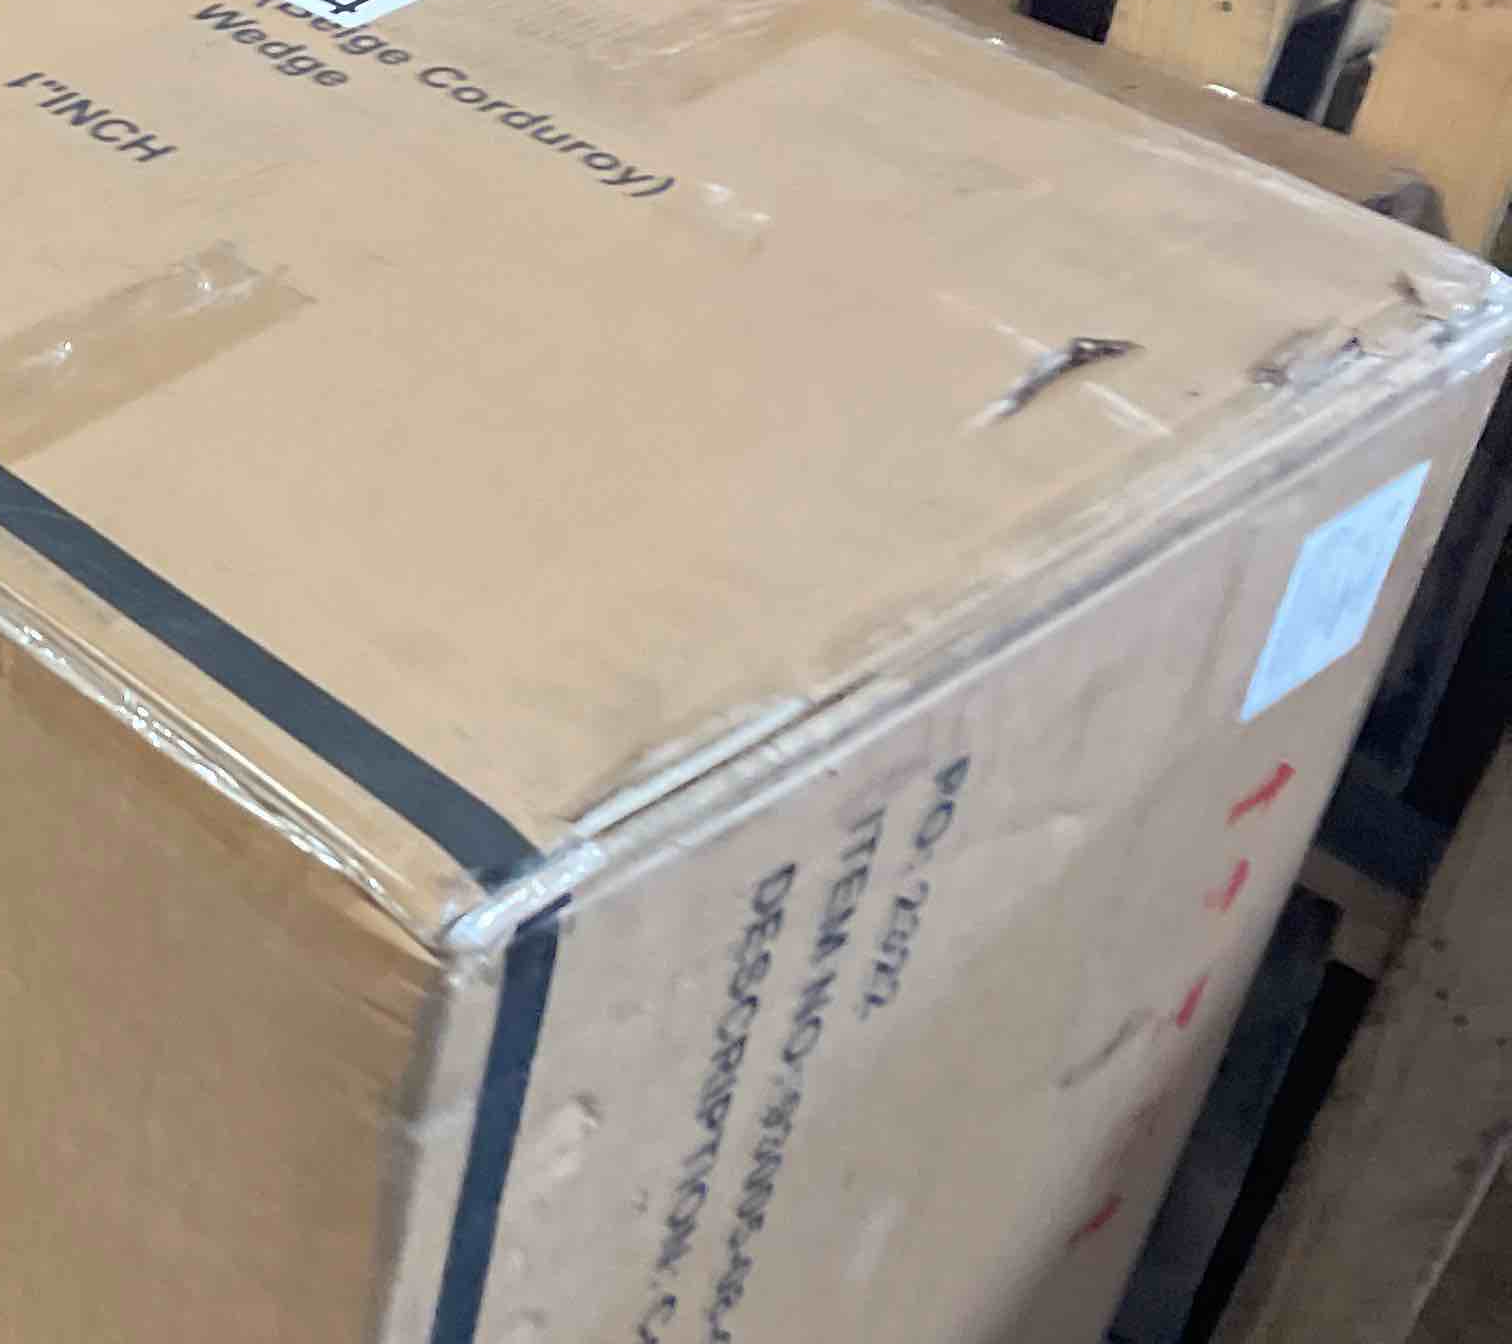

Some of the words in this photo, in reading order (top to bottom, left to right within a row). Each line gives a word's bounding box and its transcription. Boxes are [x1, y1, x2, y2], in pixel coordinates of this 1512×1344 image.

[191, 2, 349, 88] Wedge
[418, 65, 676, 198] Corduroy)
[812, 804, 887, 965] ITEM
